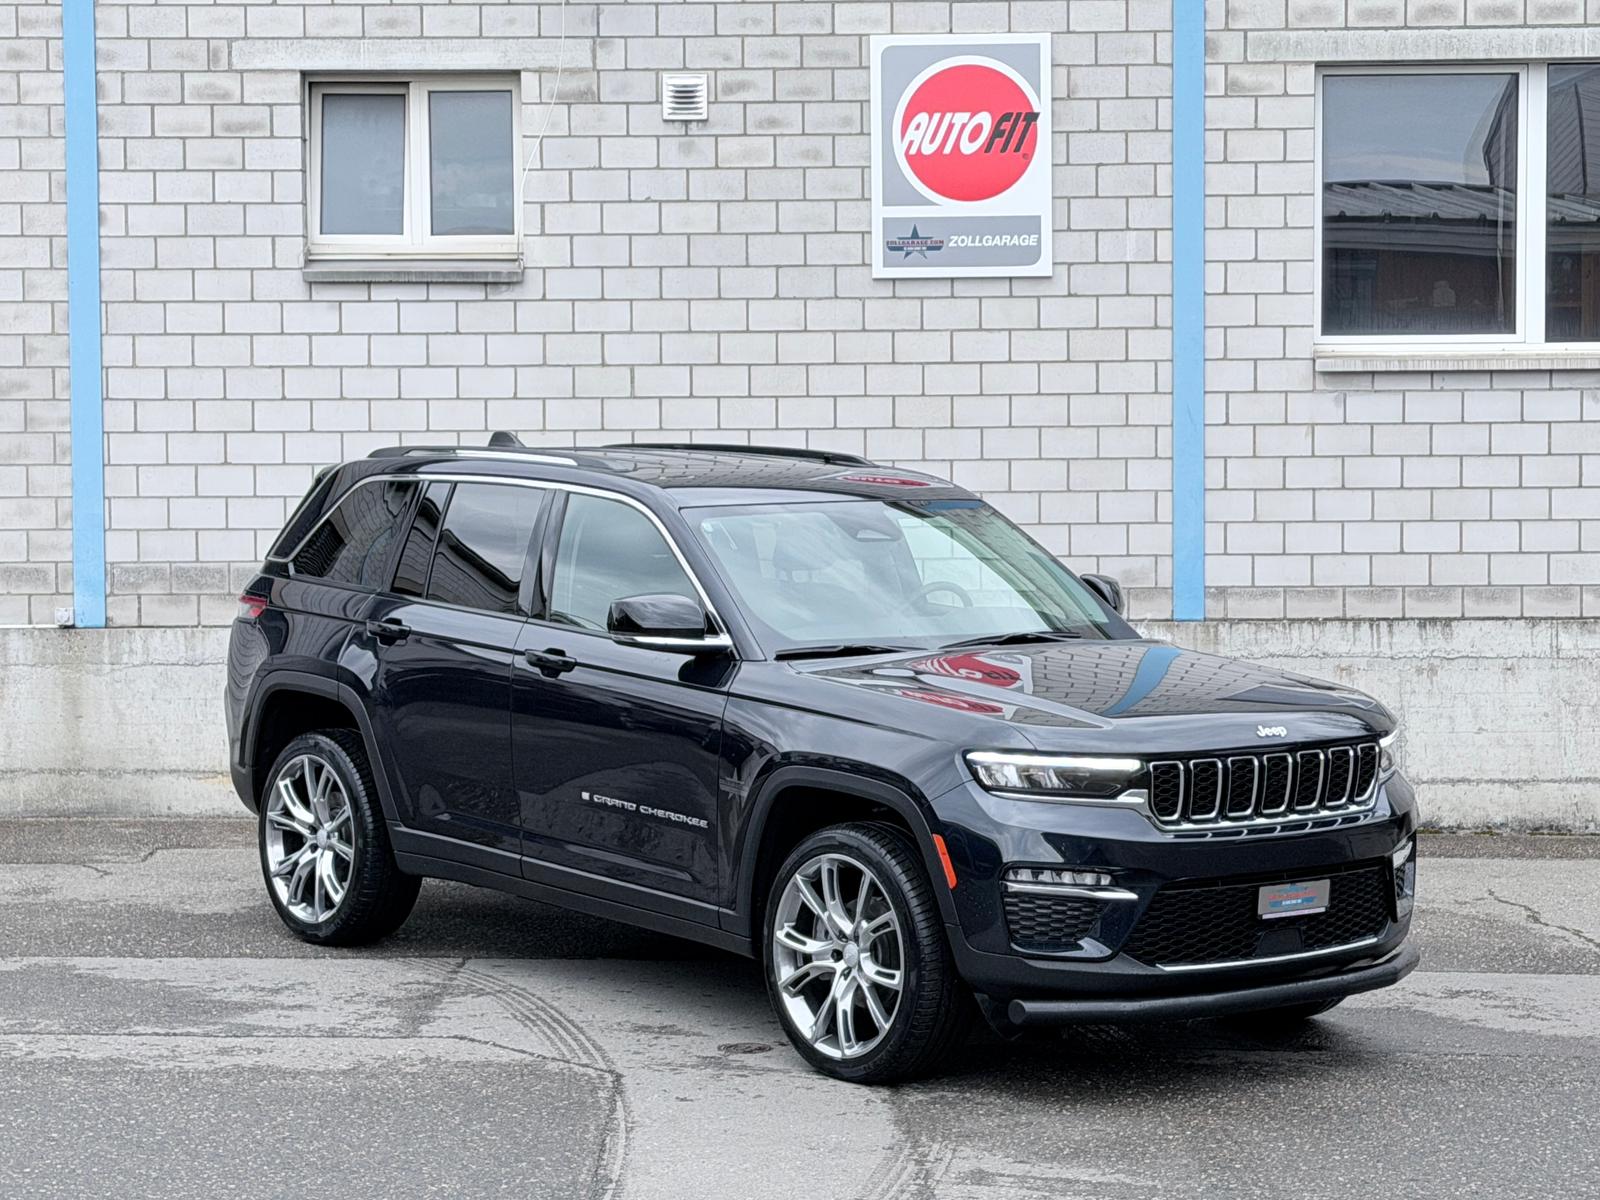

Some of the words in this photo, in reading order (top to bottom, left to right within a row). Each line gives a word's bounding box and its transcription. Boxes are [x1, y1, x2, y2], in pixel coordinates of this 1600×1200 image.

[903, 111, 1041, 156] AUTOFIT
[948, 234, 1039, 247] ZOLLGARAGE
[1256, 724, 1288, 738] Jeep
[593, 794, 637, 811] GRAND
[639, 804, 709, 829] CHEROKEE
